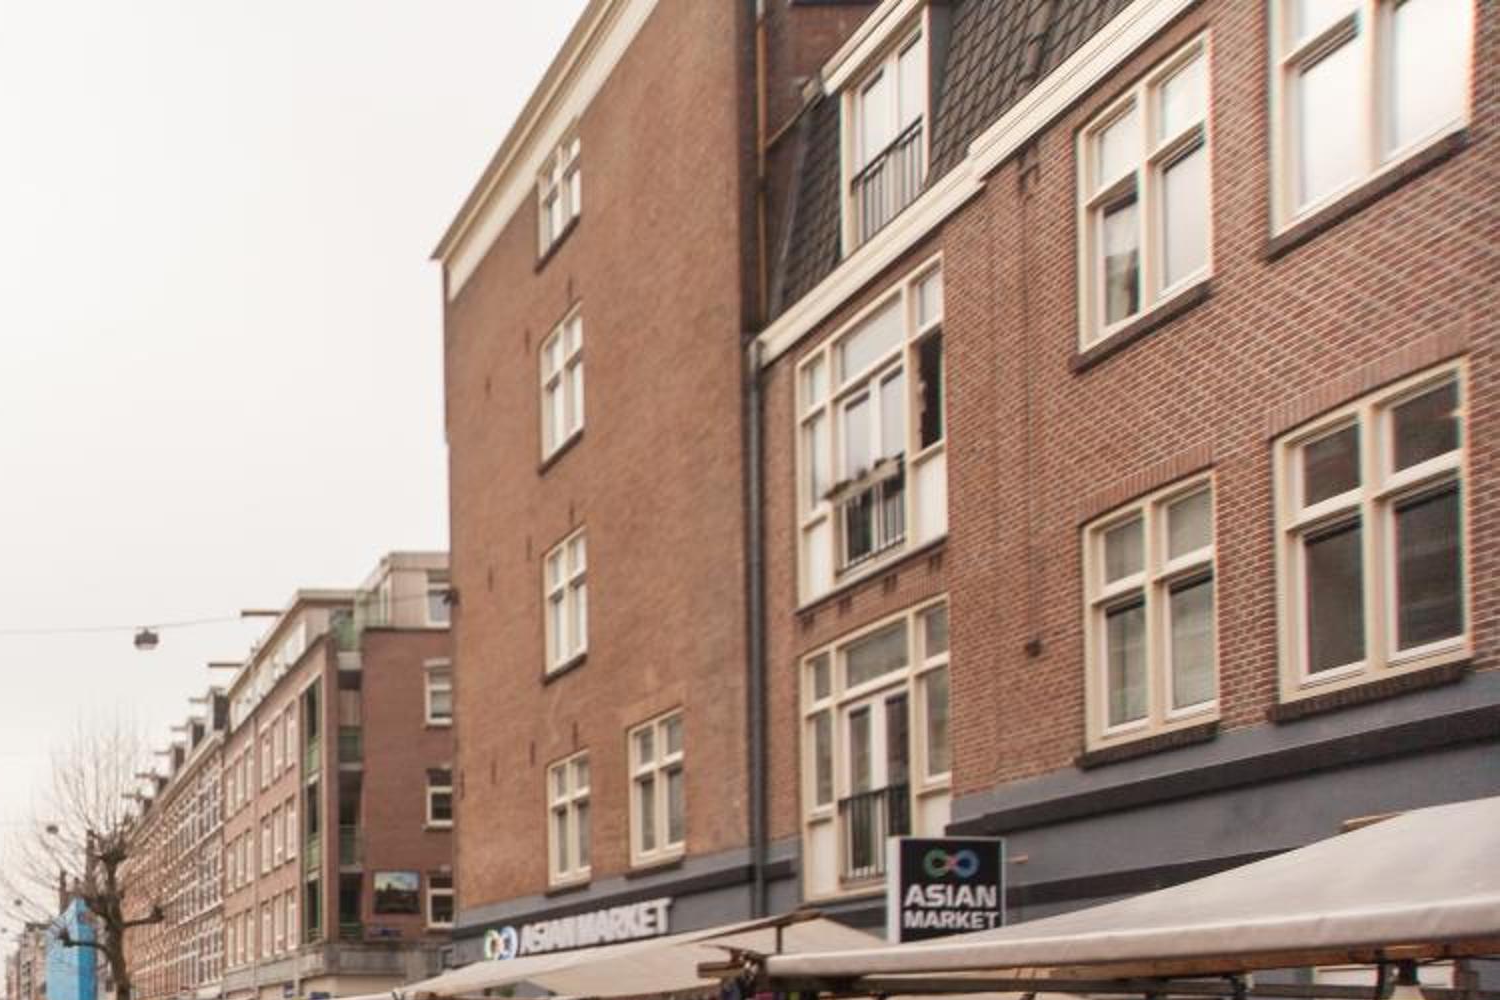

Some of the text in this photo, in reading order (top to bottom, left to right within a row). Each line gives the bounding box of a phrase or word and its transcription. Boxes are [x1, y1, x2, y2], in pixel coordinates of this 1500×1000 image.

[903, 883, 997, 909] ASIAN
[520, 897, 674, 956] ASIAN MARKET
[903, 910, 999, 931] MARKET
